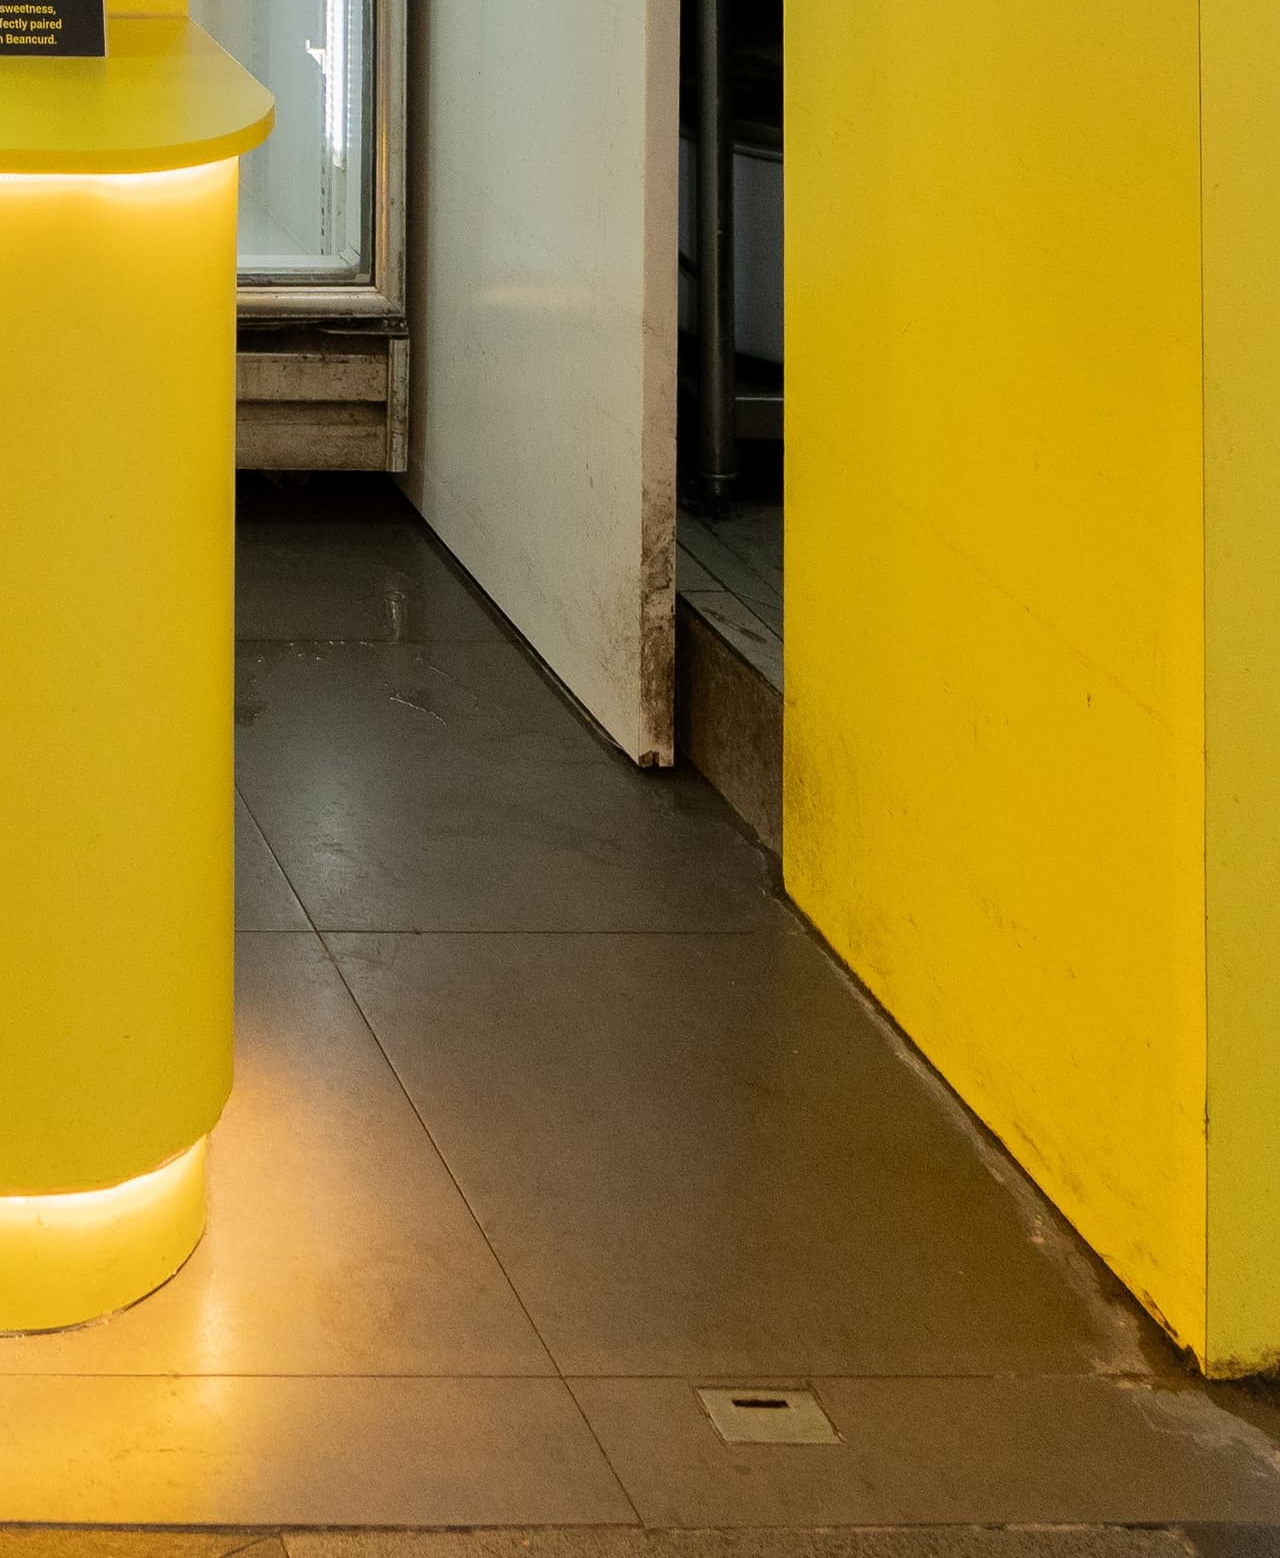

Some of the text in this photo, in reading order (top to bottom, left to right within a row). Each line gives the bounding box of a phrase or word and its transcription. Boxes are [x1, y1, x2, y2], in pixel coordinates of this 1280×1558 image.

[0, 4, 57, 15] sweetness,
[30, 19, 62, 30] paired
[6, 35, 57, 45] Beancurd.
